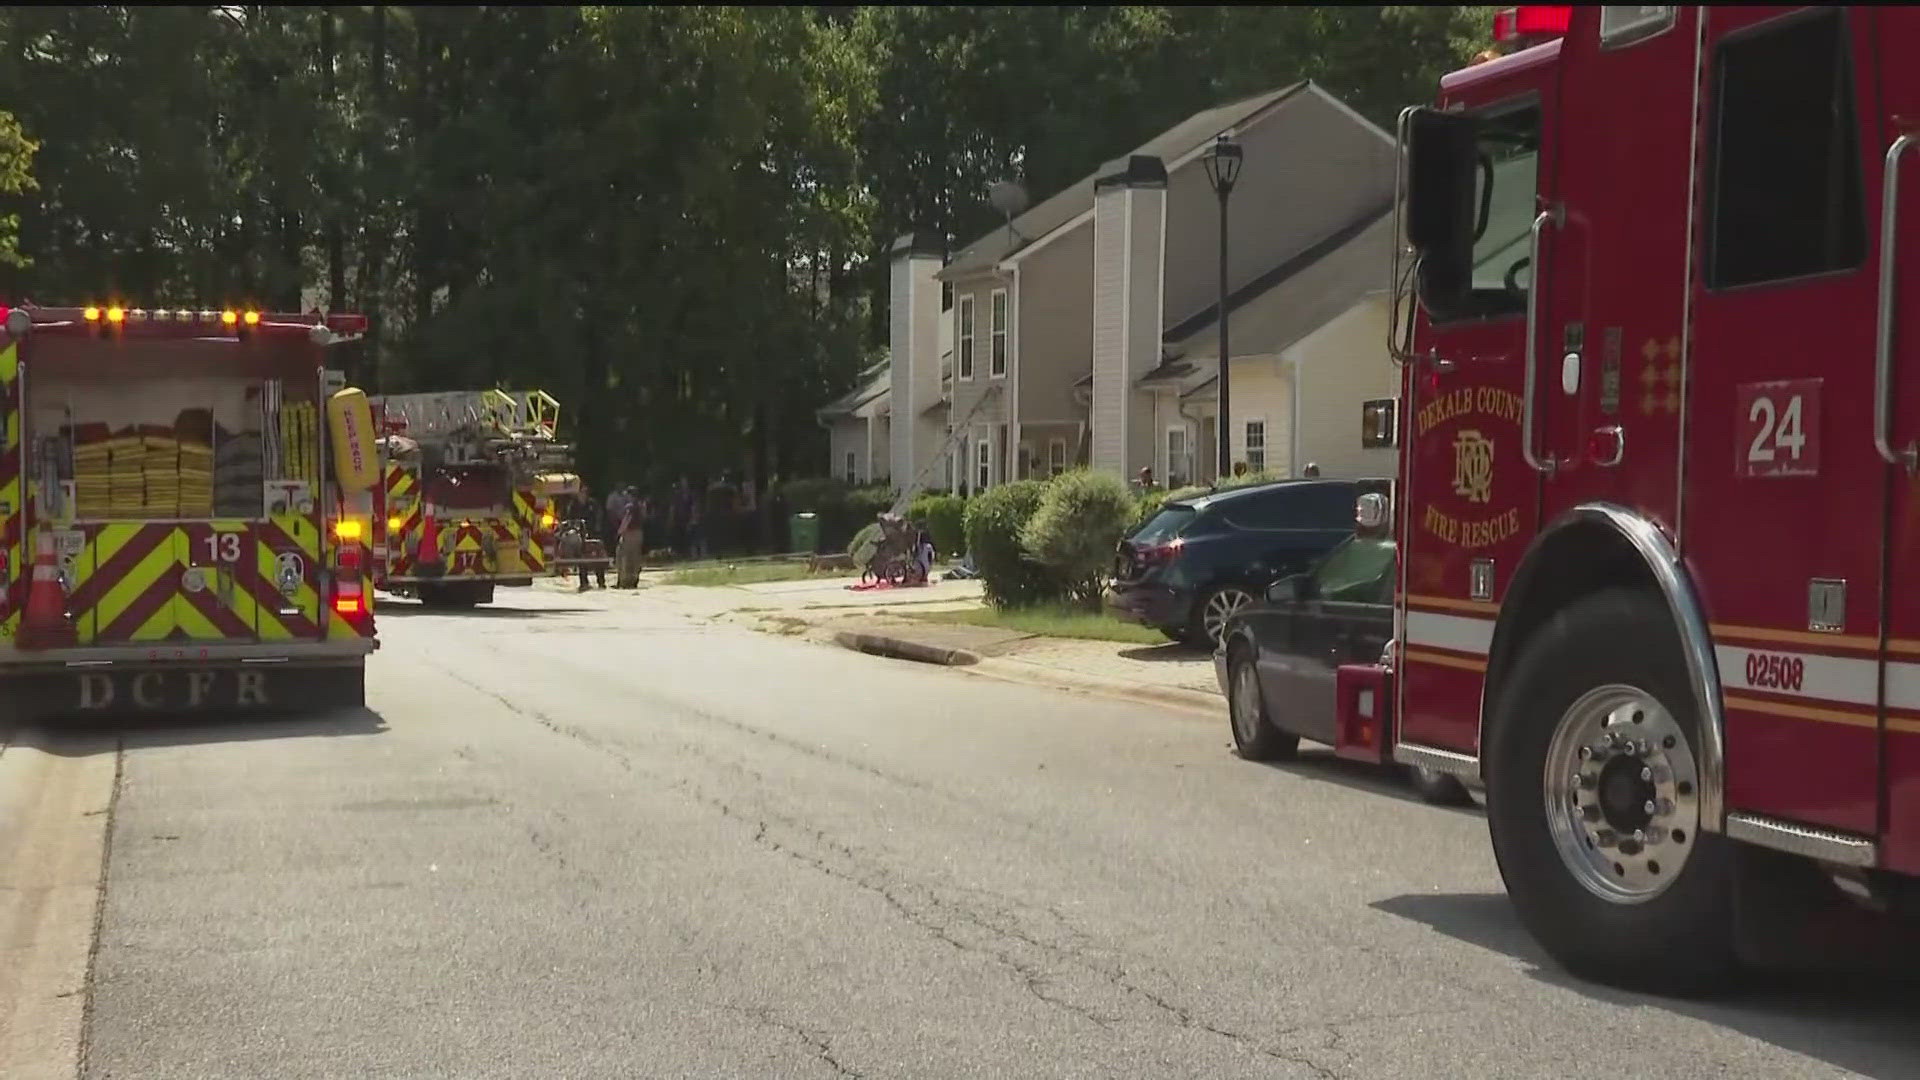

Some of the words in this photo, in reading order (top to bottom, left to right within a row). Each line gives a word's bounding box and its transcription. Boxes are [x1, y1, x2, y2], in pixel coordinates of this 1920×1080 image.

[1418, 387, 1472, 437] DEKALB
[1476, 386, 1525, 426] COUNT
[1749, 395, 1806, 460] 24
[204, 533, 241, 562] 13
[1425, 505, 1457, 543] FIRE
[1462, 507, 1520, 548] RESCUE
[1746, 652, 1803, 691] 02508
